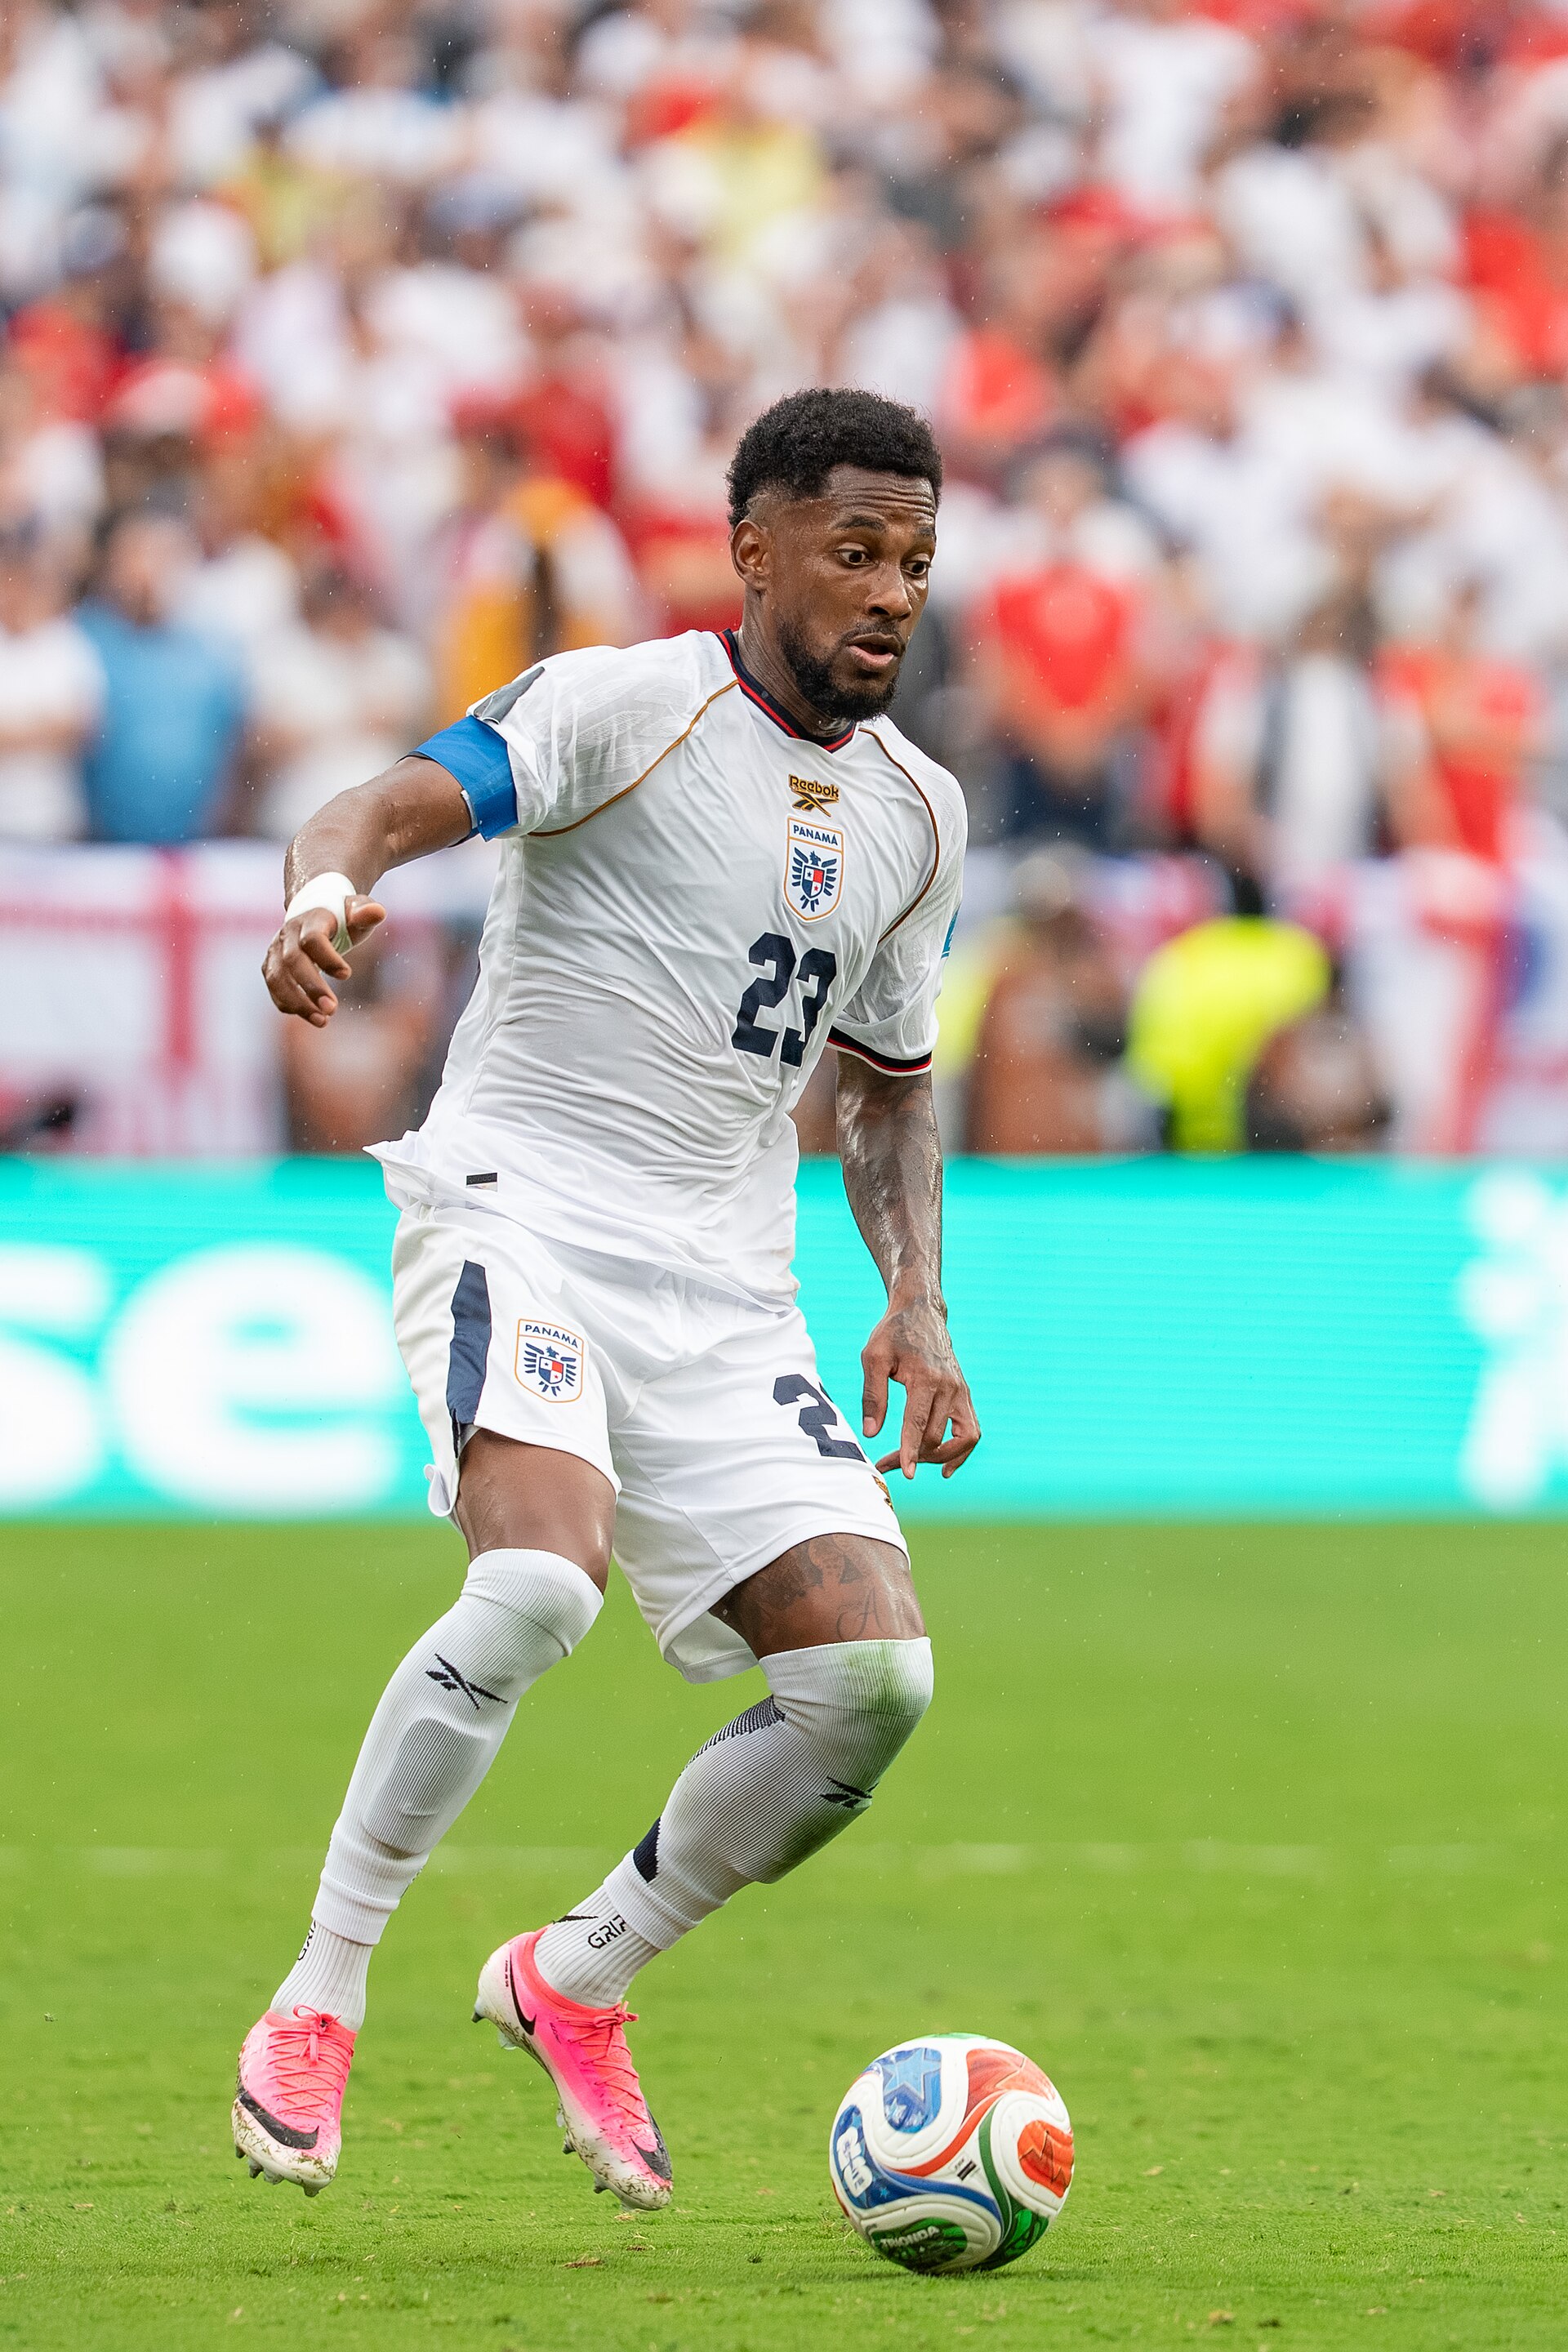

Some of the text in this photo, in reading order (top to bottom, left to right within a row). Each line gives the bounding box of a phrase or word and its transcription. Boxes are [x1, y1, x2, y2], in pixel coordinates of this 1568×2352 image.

[789, 774, 839, 798] Reebok
[732, 932, 837, 1067] 23
[773, 1374, 867, 1463] 2
